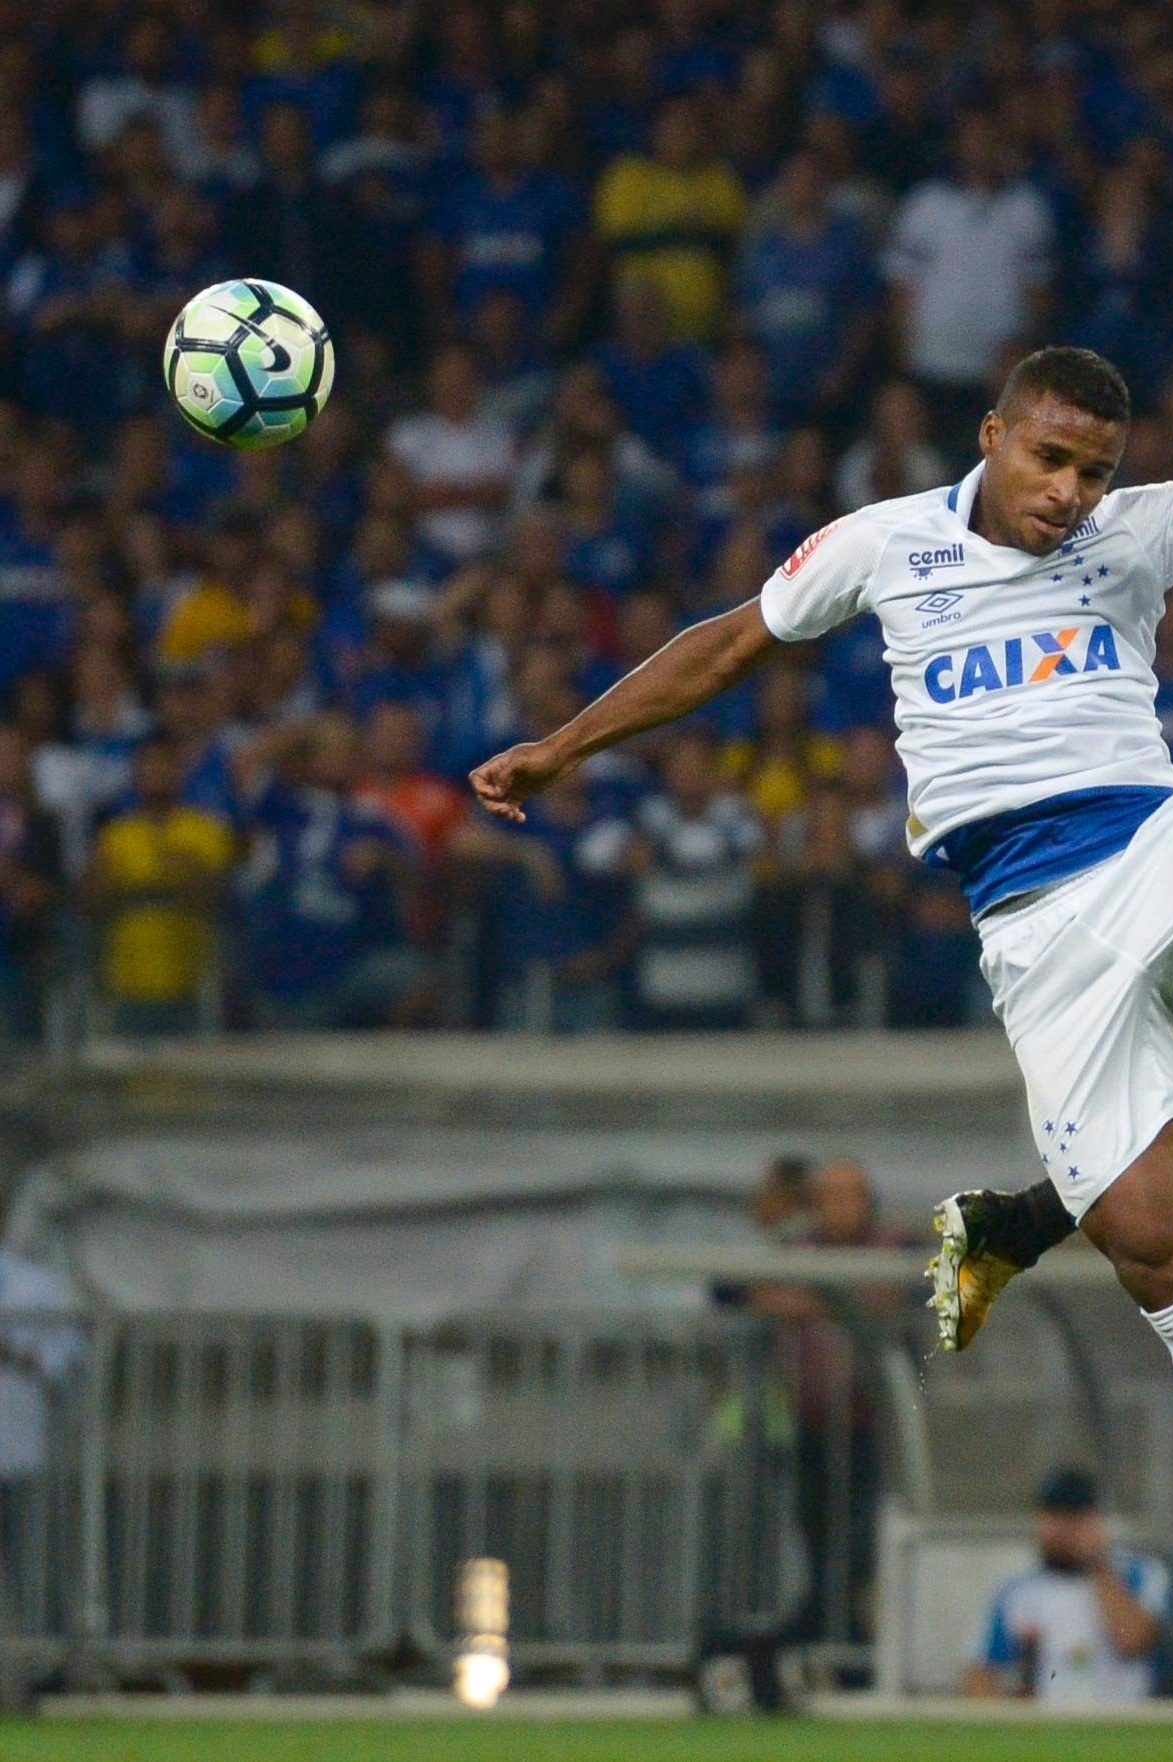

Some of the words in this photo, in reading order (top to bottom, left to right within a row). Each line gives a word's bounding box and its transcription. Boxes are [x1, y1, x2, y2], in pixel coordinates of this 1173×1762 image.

[908, 543, 965, 566] cemil
[921, 611, 962, 629] umbro
[923, 624, 1121, 704] CAIXA
